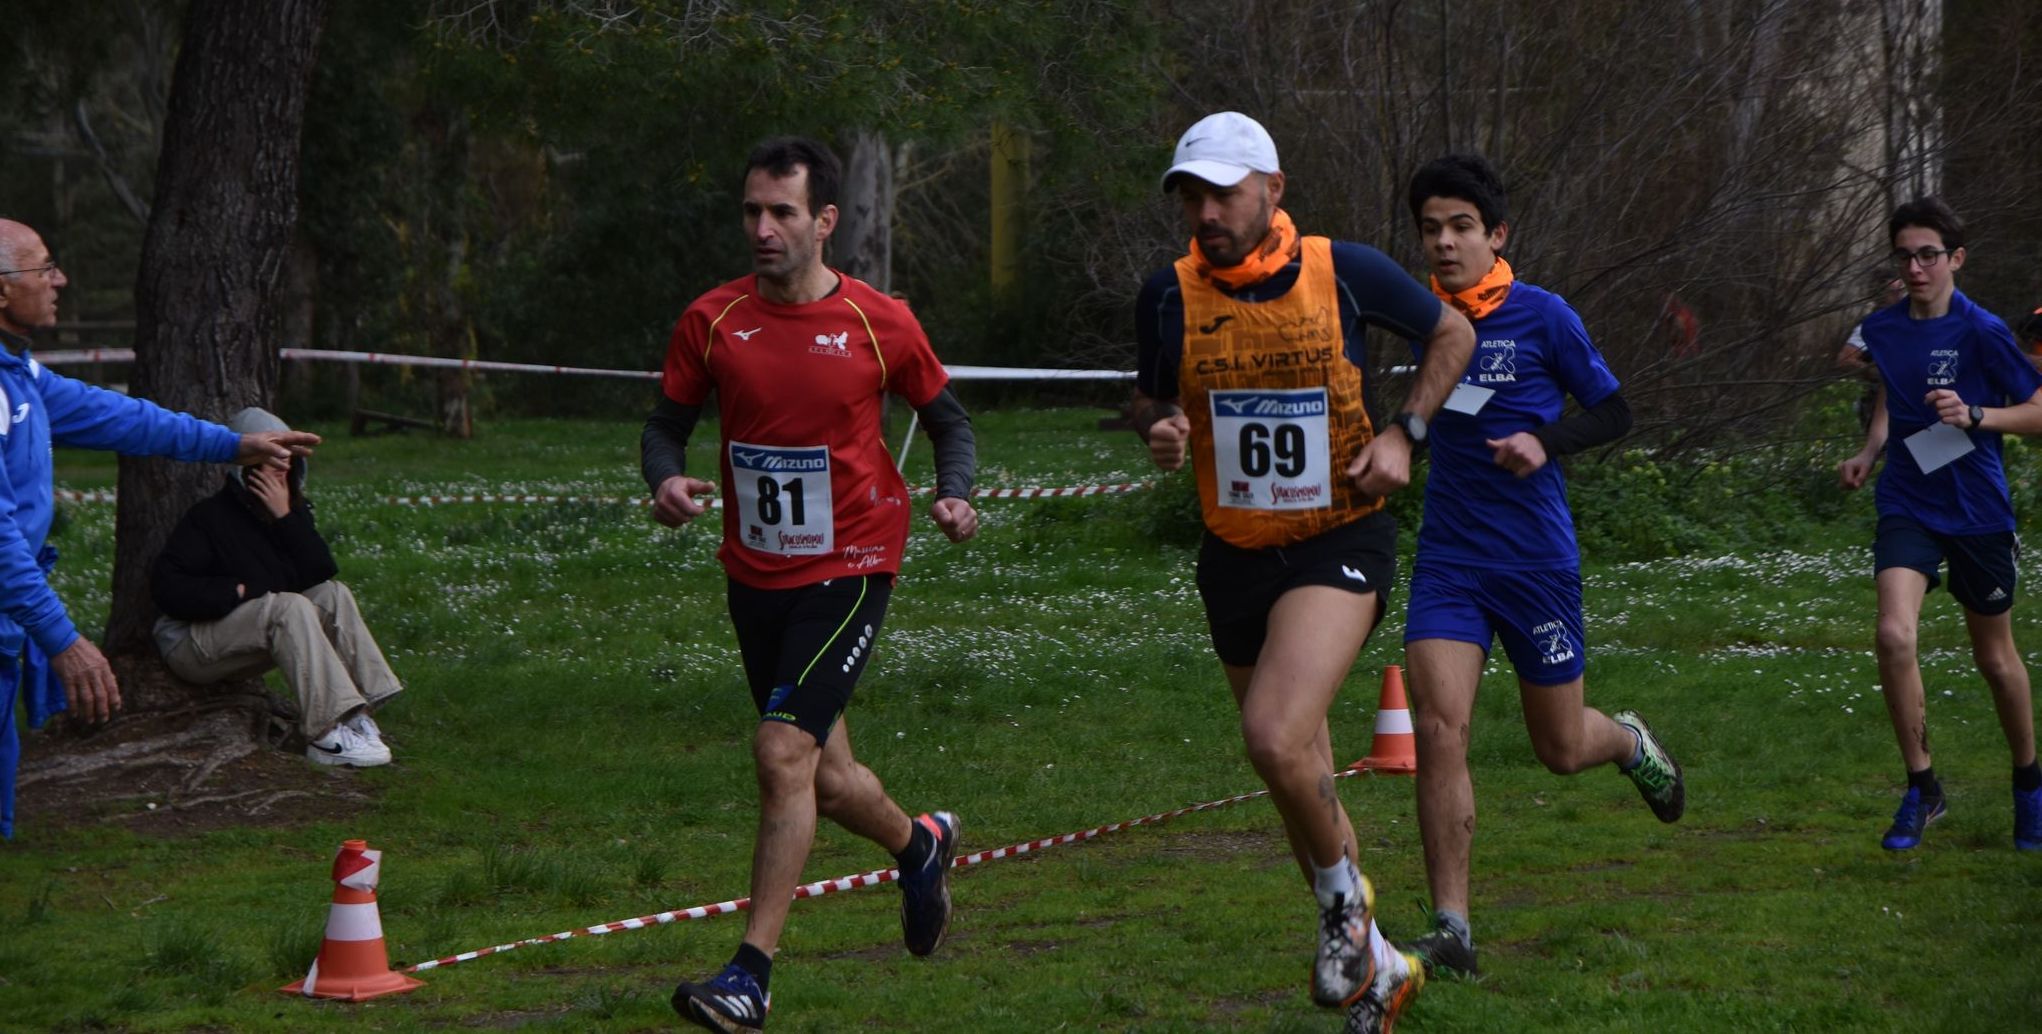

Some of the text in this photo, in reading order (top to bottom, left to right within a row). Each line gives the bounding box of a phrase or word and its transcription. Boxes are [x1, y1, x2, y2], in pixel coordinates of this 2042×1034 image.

[1481, 339, 1516, 348] ATLETICA
[1251, 348, 1333, 369] VIRTUS
[1479, 373, 1516, 382] ELBA
[1927, 377, 1956, 385] ELBA
[1239, 422, 1306, 478] 69
[757, 475, 805, 526] 81
[1542, 650, 1575, 664] ELBA
